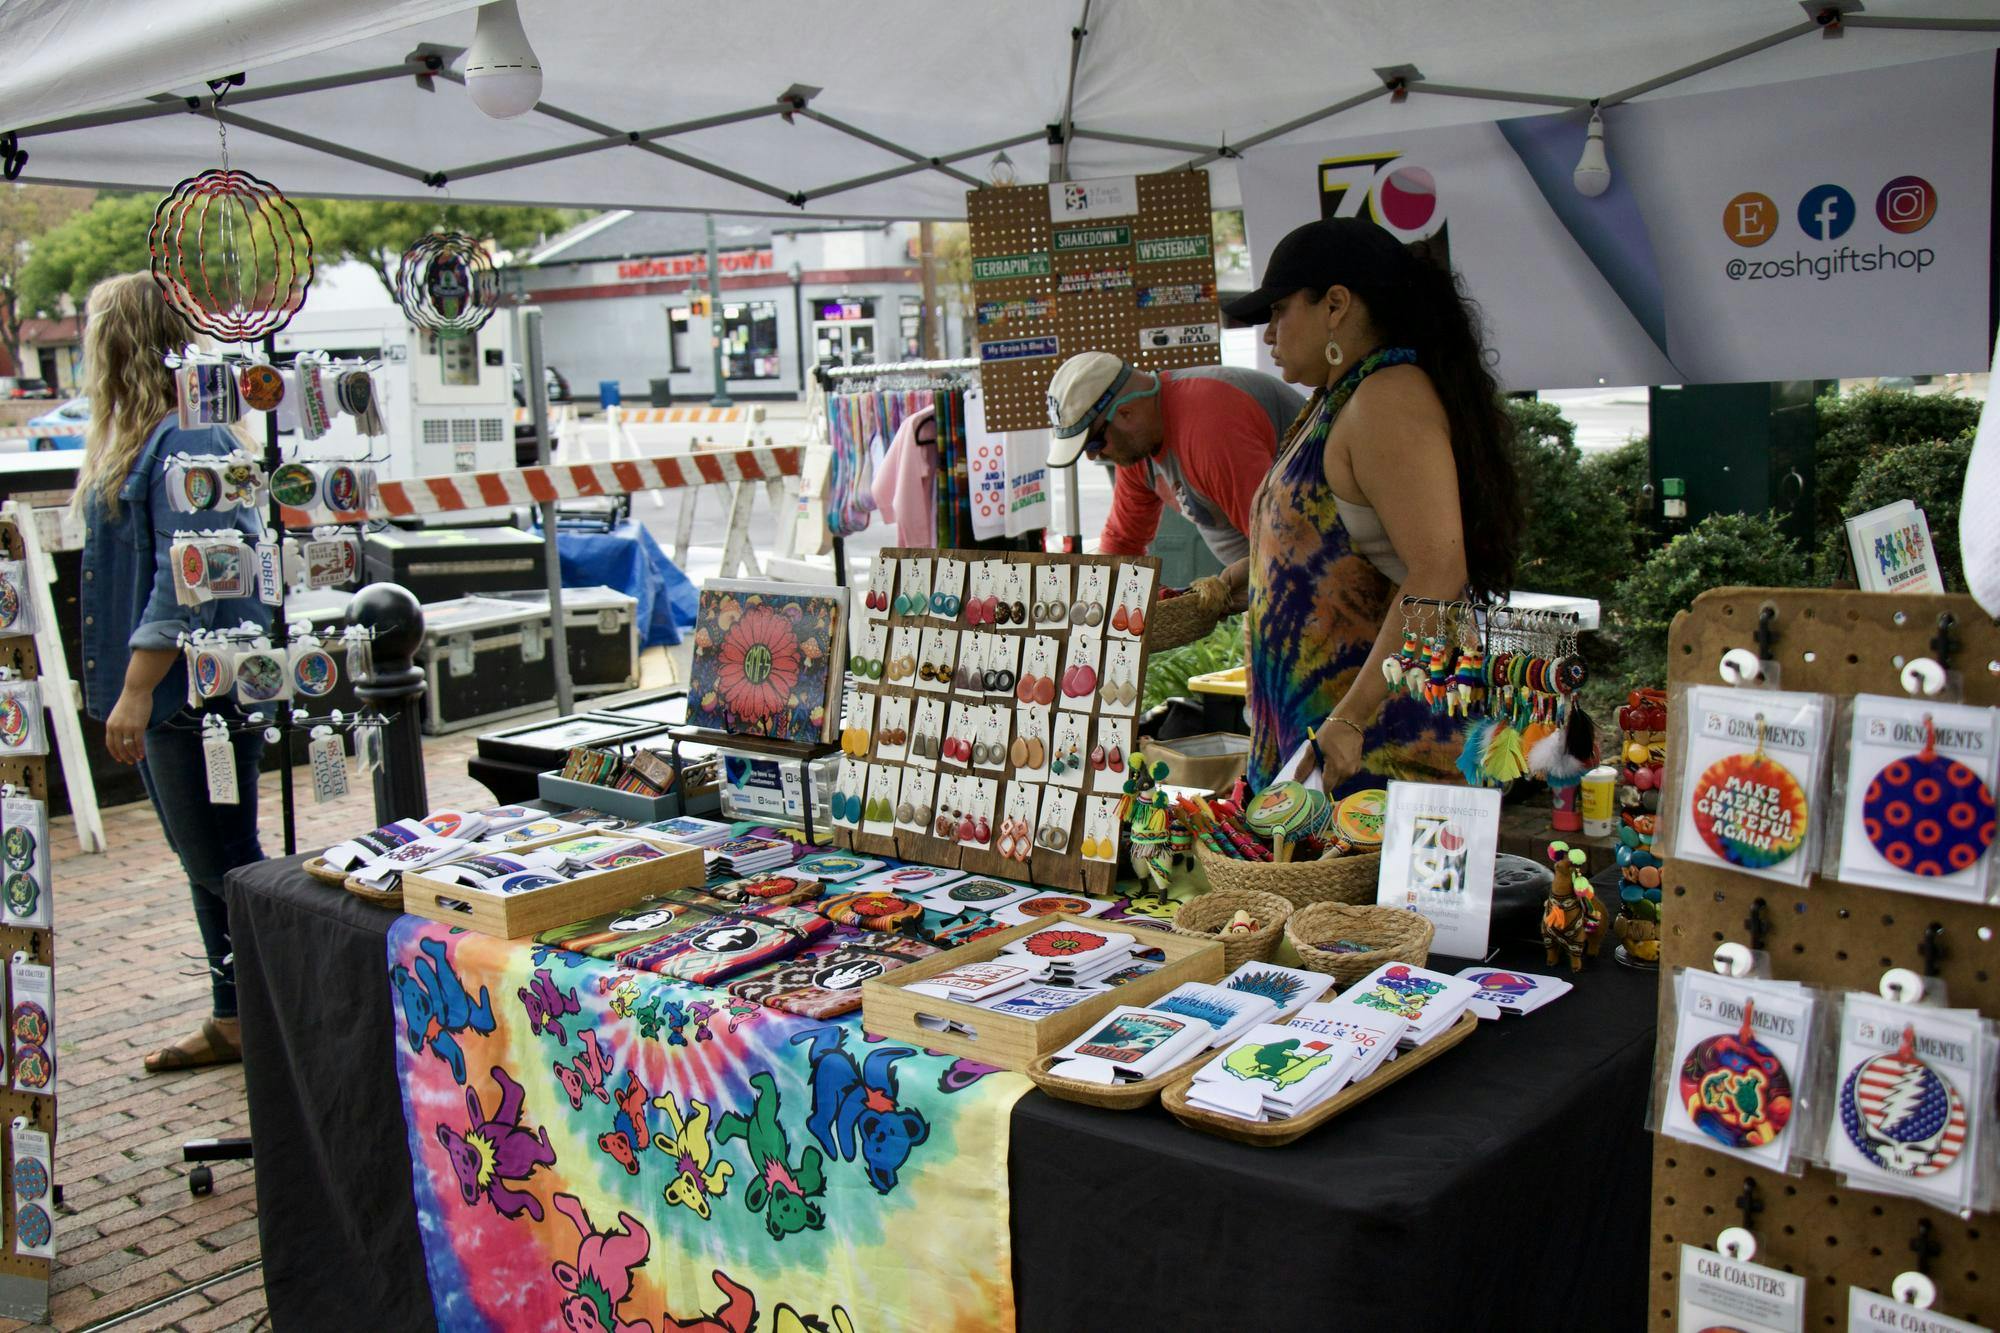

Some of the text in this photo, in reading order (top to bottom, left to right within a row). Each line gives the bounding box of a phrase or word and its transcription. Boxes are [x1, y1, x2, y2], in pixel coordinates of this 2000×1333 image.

[1058, 230, 1117, 248] SHAKEDOWN
[1140, 240, 1197, 259] WYSTERIA
[976, 259, 1029, 277] TERRAPIN
[1725, 244, 1935, 280] @zoshgiftshop
[1179, 335, 1210, 345] HEAD
[1184, 326, 1205, 335] POT
[261, 551, 274, 596] SOBER
[316, 750, 332, 796] DOLLY
[332, 762, 344, 795] REBA
[1705, 785, 1792, 825] AMERICA
[1725, 776, 1780, 803] MAKE
[1439, 806, 1488, 818] CONNECTED
[1697, 799, 1794, 842] GRATEFUL
[1711, 820, 1771, 850] AGAIN
[1719, 1001, 1794, 1035] ORNMENTS
[1882, 1027, 1964, 1062] ORMENTS
[1697, 1258, 1721, 1279] CAR
[1724, 1266, 1785, 1298] COASTERS
[1869, 1303, 1896, 1327] CAR
